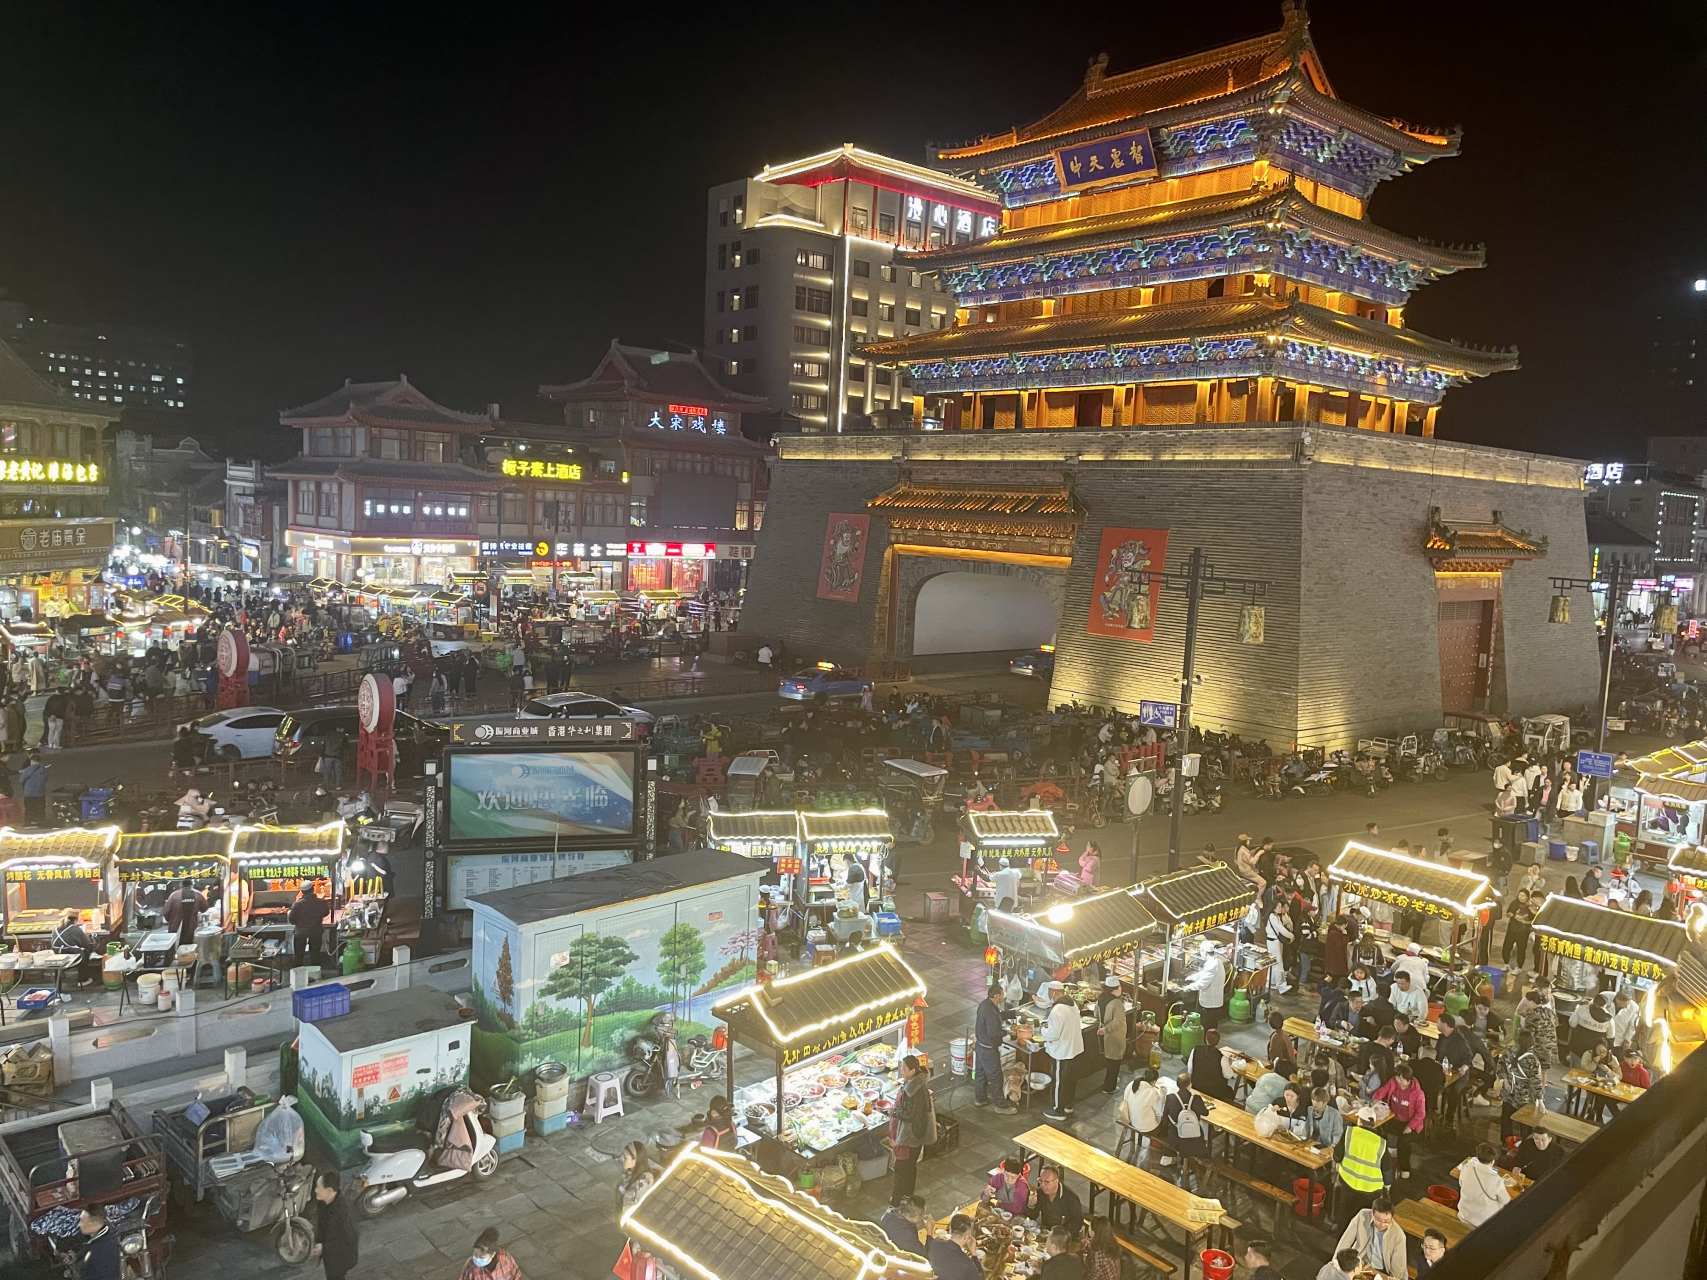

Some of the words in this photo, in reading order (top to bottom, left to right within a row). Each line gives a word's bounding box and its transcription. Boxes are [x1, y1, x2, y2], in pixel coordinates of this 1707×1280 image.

[648, 411, 727, 435] 大宋戏楼
[477, 784, 608, 811] 欢迎您光临
